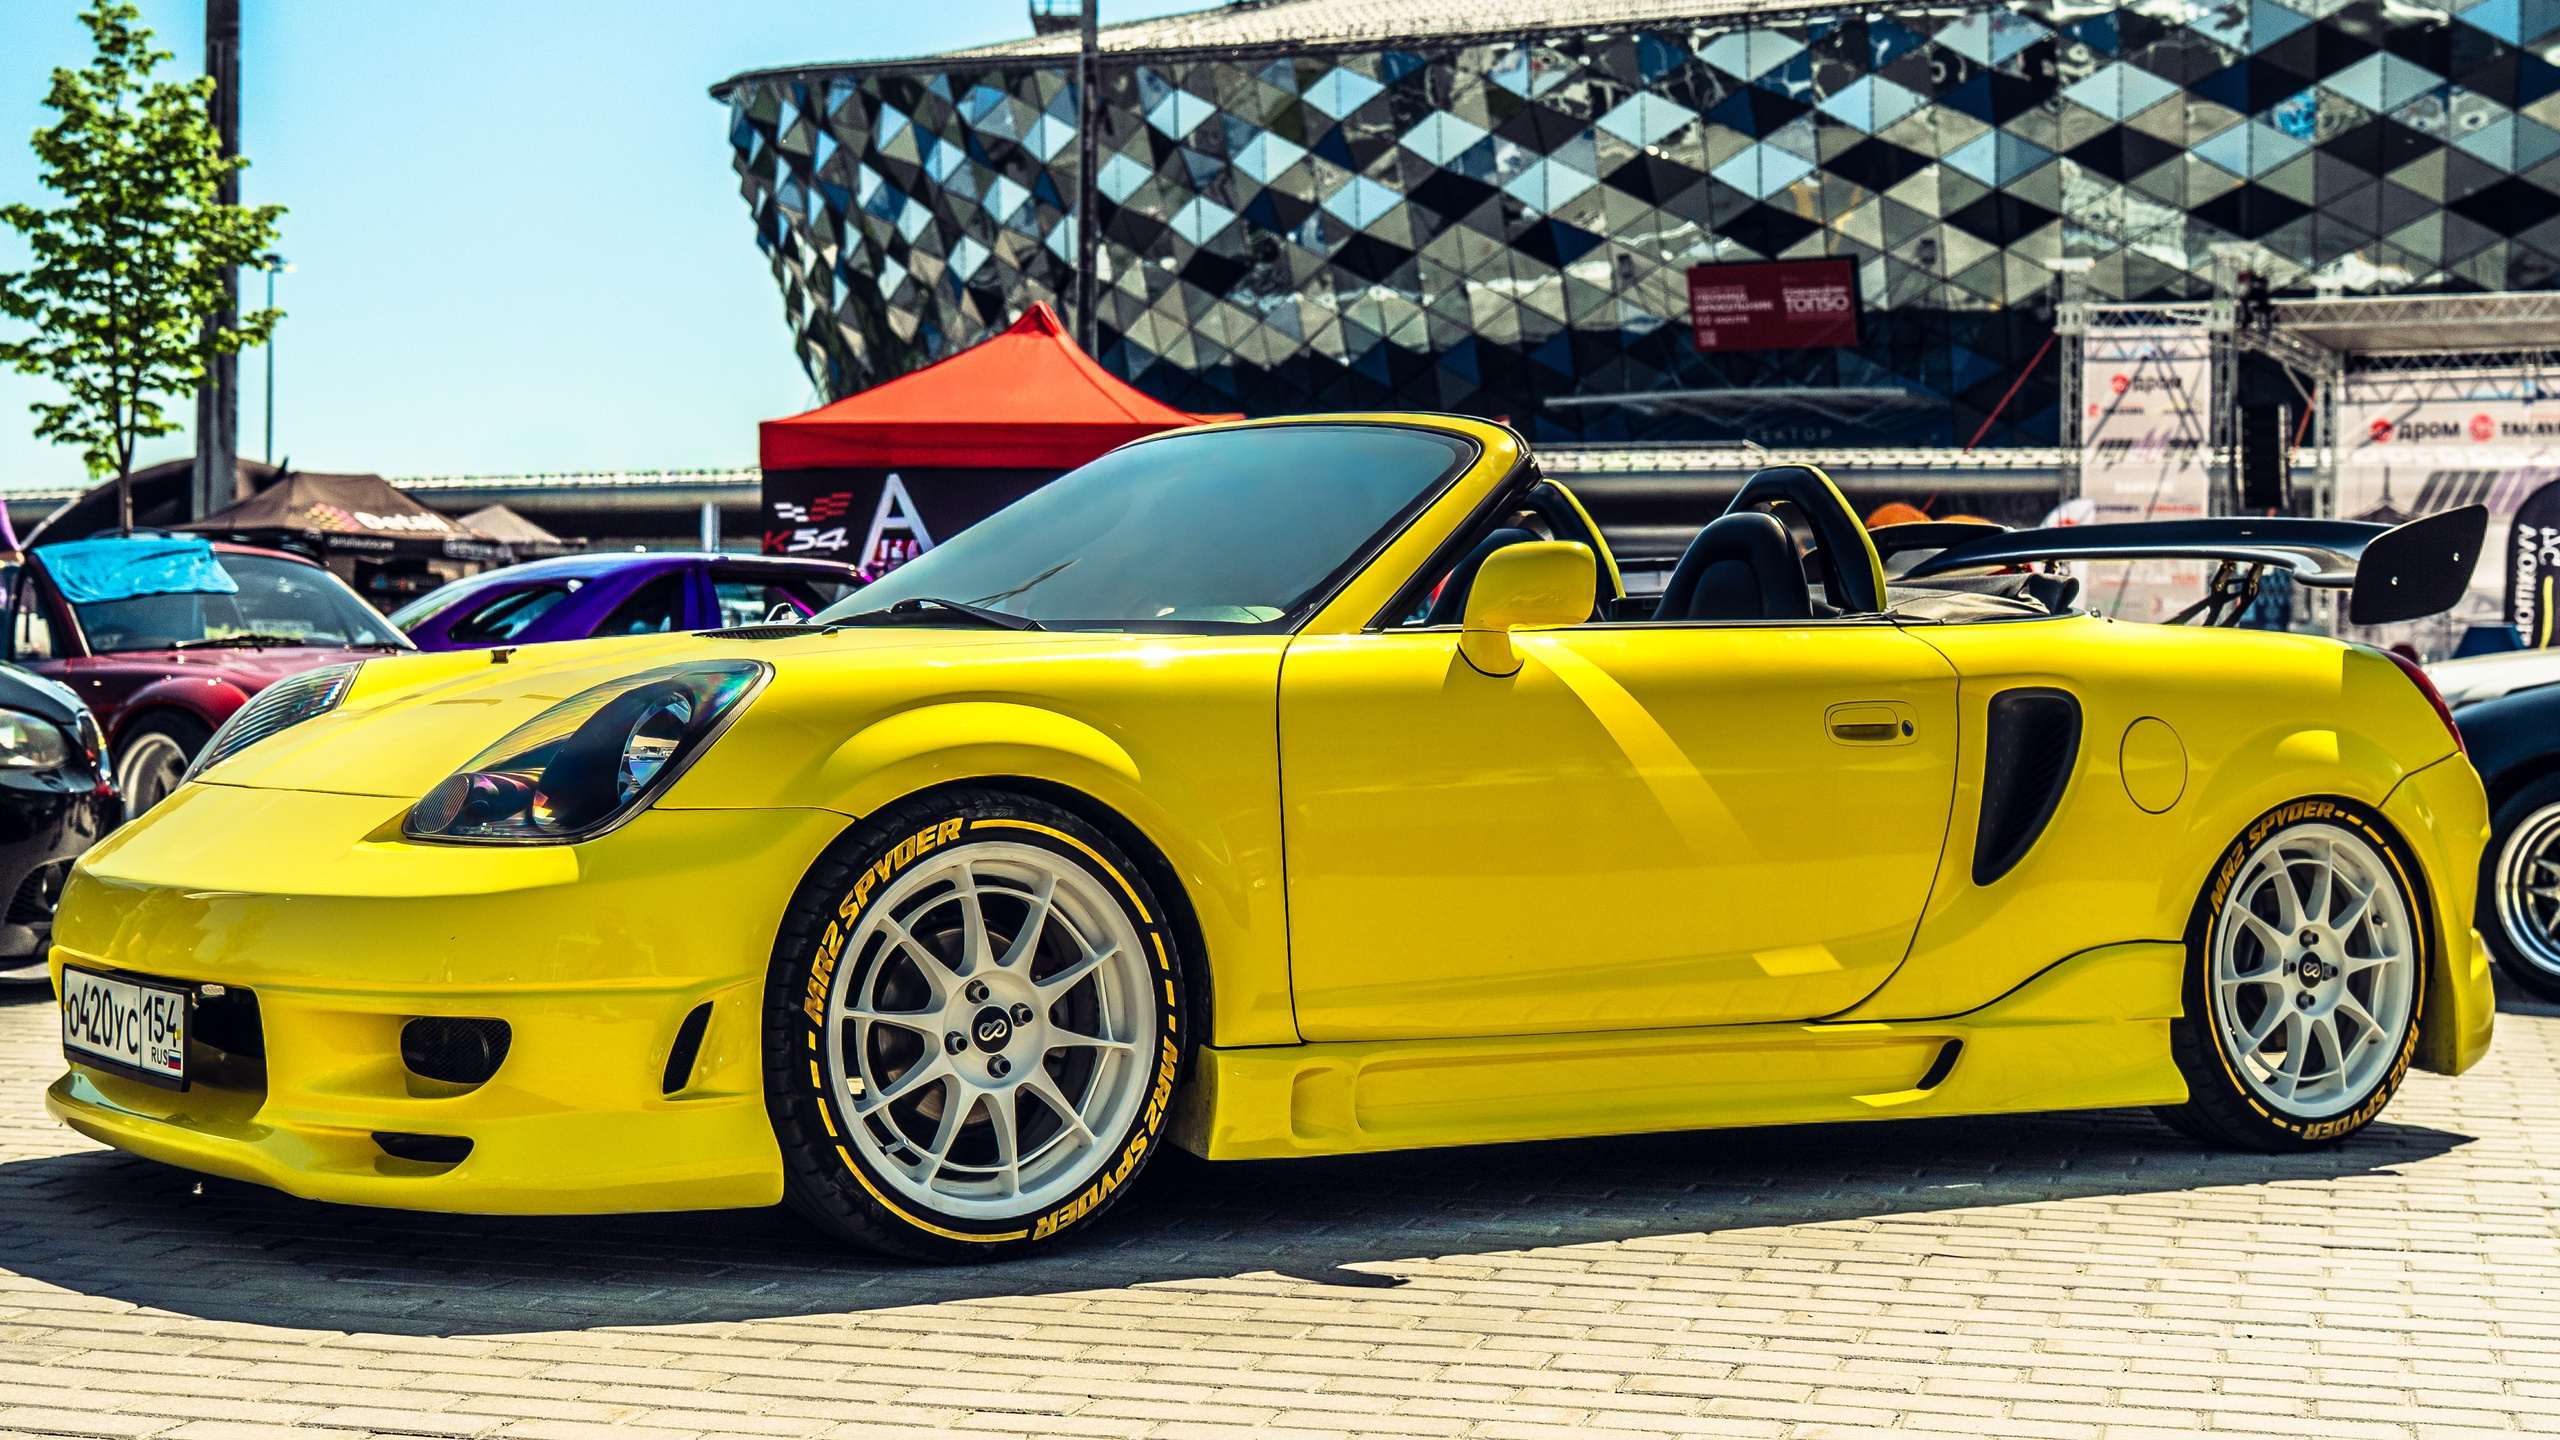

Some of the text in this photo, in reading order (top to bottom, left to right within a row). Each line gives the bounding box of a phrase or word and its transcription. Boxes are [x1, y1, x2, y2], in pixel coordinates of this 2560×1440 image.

[2210, 801, 2336, 916] MR2 SPYDER
[804, 817, 964, 1028] MR2 SPYDER
[143, 995, 177, 1048] 154
[151, 1046, 168, 1066] RUS
[1033, 1035, 1179, 1240] MR2 SPYDER
[2302, 1084, 2387, 1140] SPYDER
